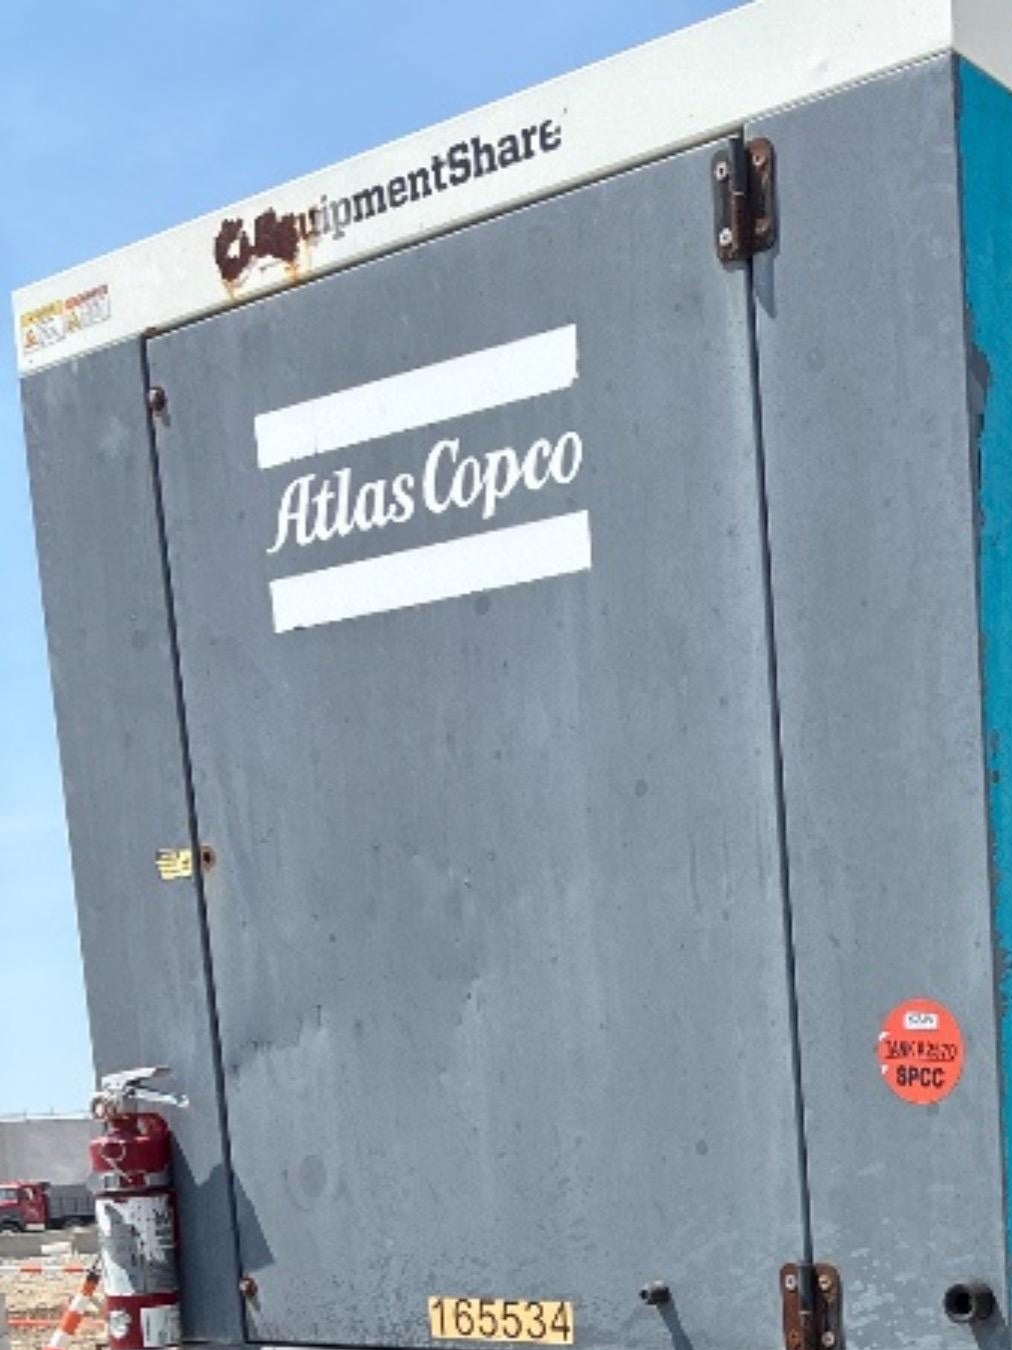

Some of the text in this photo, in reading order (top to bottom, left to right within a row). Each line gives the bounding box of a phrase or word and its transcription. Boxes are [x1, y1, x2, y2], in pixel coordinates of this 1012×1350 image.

[254, 119, 563, 258] uipmentShare
[265, 430, 584, 555] Atlas Copco
[896, 1065, 946, 1089] SPCC
[431, 1299, 571, 1342] 165534
